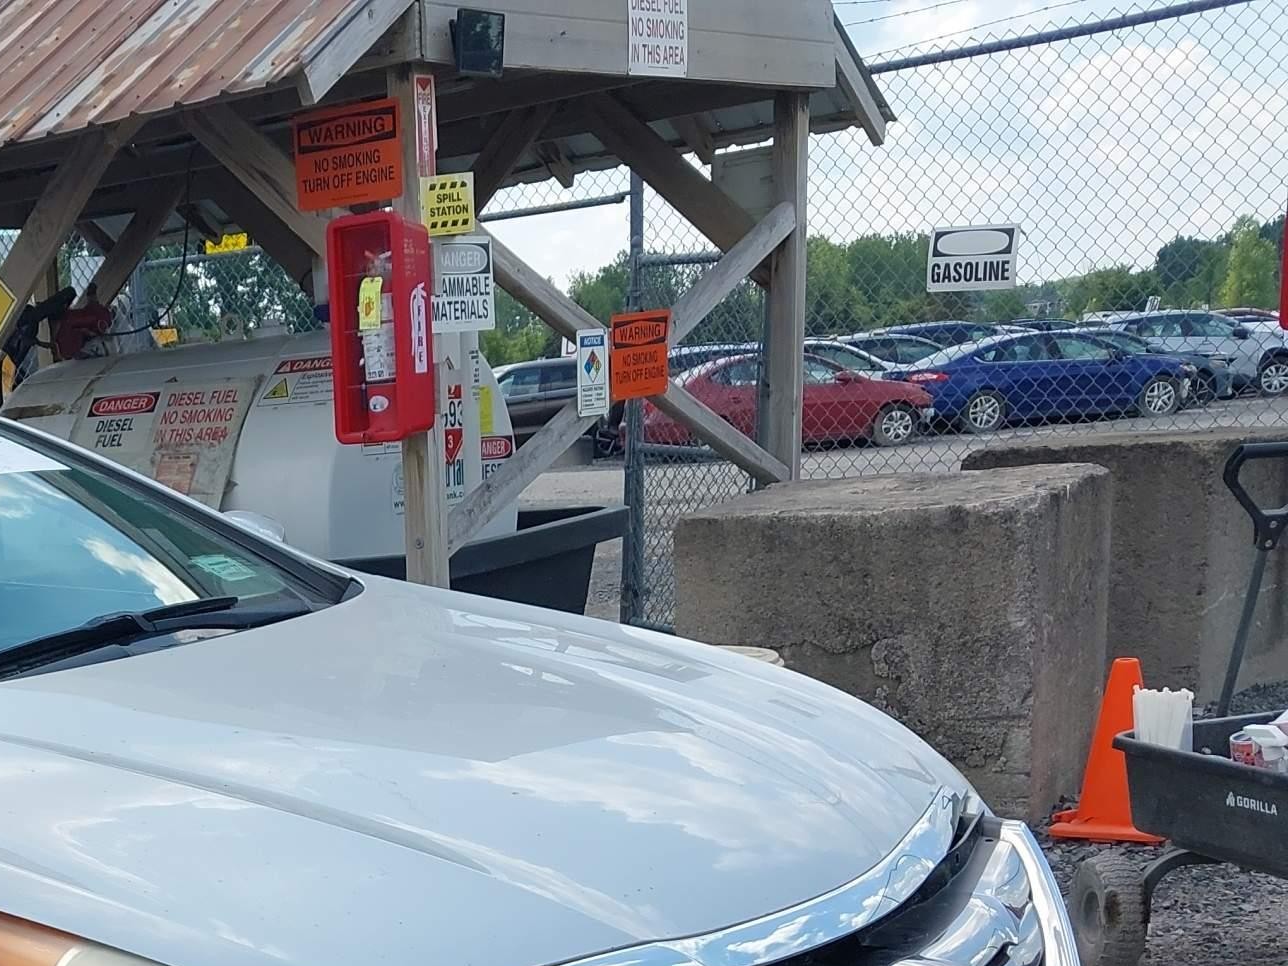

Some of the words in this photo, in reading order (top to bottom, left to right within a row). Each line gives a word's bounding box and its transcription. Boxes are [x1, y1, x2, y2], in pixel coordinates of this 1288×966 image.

[632, 0, 661, 12] DIESEL
[664, 0, 684, 14] FUEL
[632, 17, 643, 37] NO
[647, 18, 684, 40] SMOKING
[632, 44, 639, 63] IN
[642, 44, 660, 64] THIS
[663, 46, 684, 65] AREA
[308, 116, 385, 144] WARNING
[314, 158, 328, 173] NO
[332, 148, 380, 171] SMOKING
[303, 176, 329, 193] TURN
[333, 172, 352, 189] OFF
[355, 165, 394, 185] ENGINE
[436, 192, 462, 204] SPILL
[429, 203, 468, 218] STATION
[931, 260, 1010, 284] GASOLINE
[435, 275, 490, 298] AMMABLE
[432, 299, 489, 322] MATERIALS
[620, 324, 660, 342] WARNING
[293, 358, 333, 370] DANG
[623, 354, 631, 367] NO
[632, 350, 657, 365] SMOKING
[616, 371, 631, 384] TURN
[632, 368, 643, 382] OFF
[644, 364, 665, 380] ENGINE
[99, 398, 148, 412] DANGER
[167, 391, 206, 407] DIESEL
[208, 389, 238, 404] FUEL
[95, 417, 133, 433] DIESEL
[160, 410, 178, 425] NO
[179, 407, 234, 424] SMOKING
[95, 433, 122, 448] FUEL
[168, 427, 194, 442] THIS
[195, 426, 229, 443] AREA
[448, 435, 453, 448] 3
[481, 442, 506, 457] ANGER
[1236, 795, 1278, 816] GORILLA
